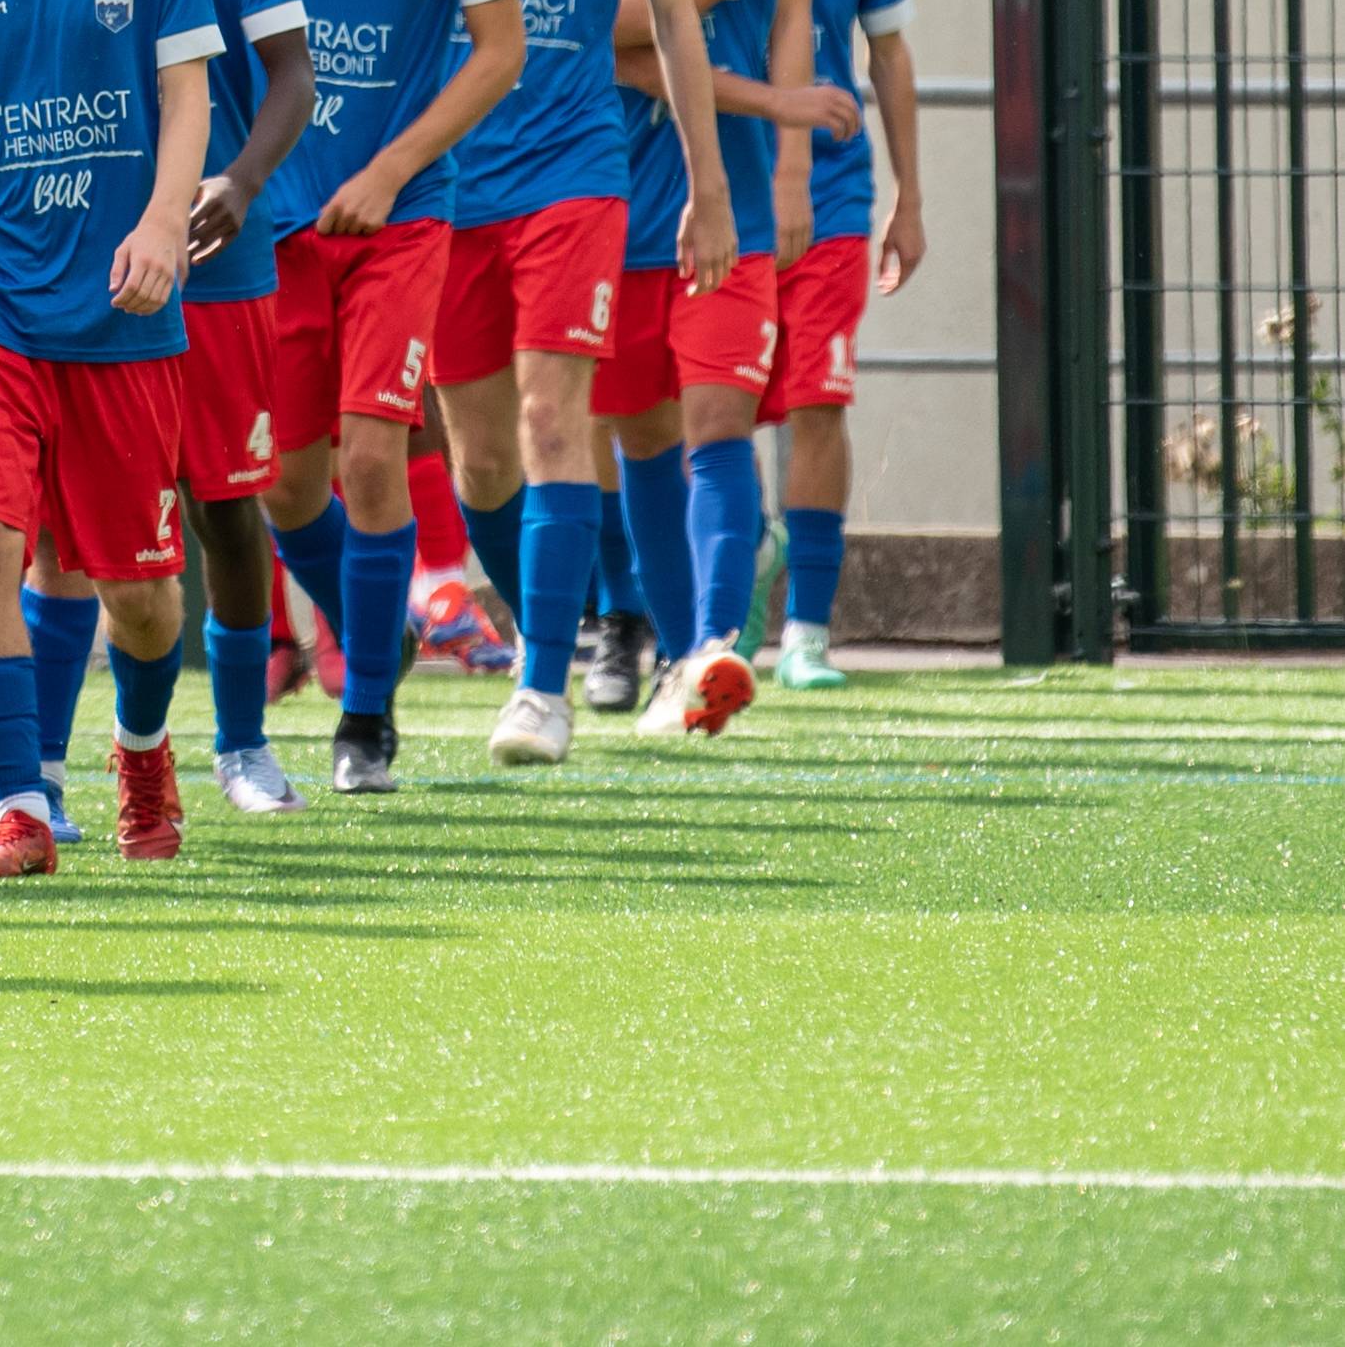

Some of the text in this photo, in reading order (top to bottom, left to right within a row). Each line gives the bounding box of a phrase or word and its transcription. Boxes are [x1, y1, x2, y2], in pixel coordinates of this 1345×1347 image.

[4, 124, 119, 158] HENNEBONT
[33, 169, 93, 215] BAR
[592, 281, 613, 332] 6
[402, 339, 426, 390] 5
[248, 411, 273, 461] 4
[157, 489, 176, 541] 2
